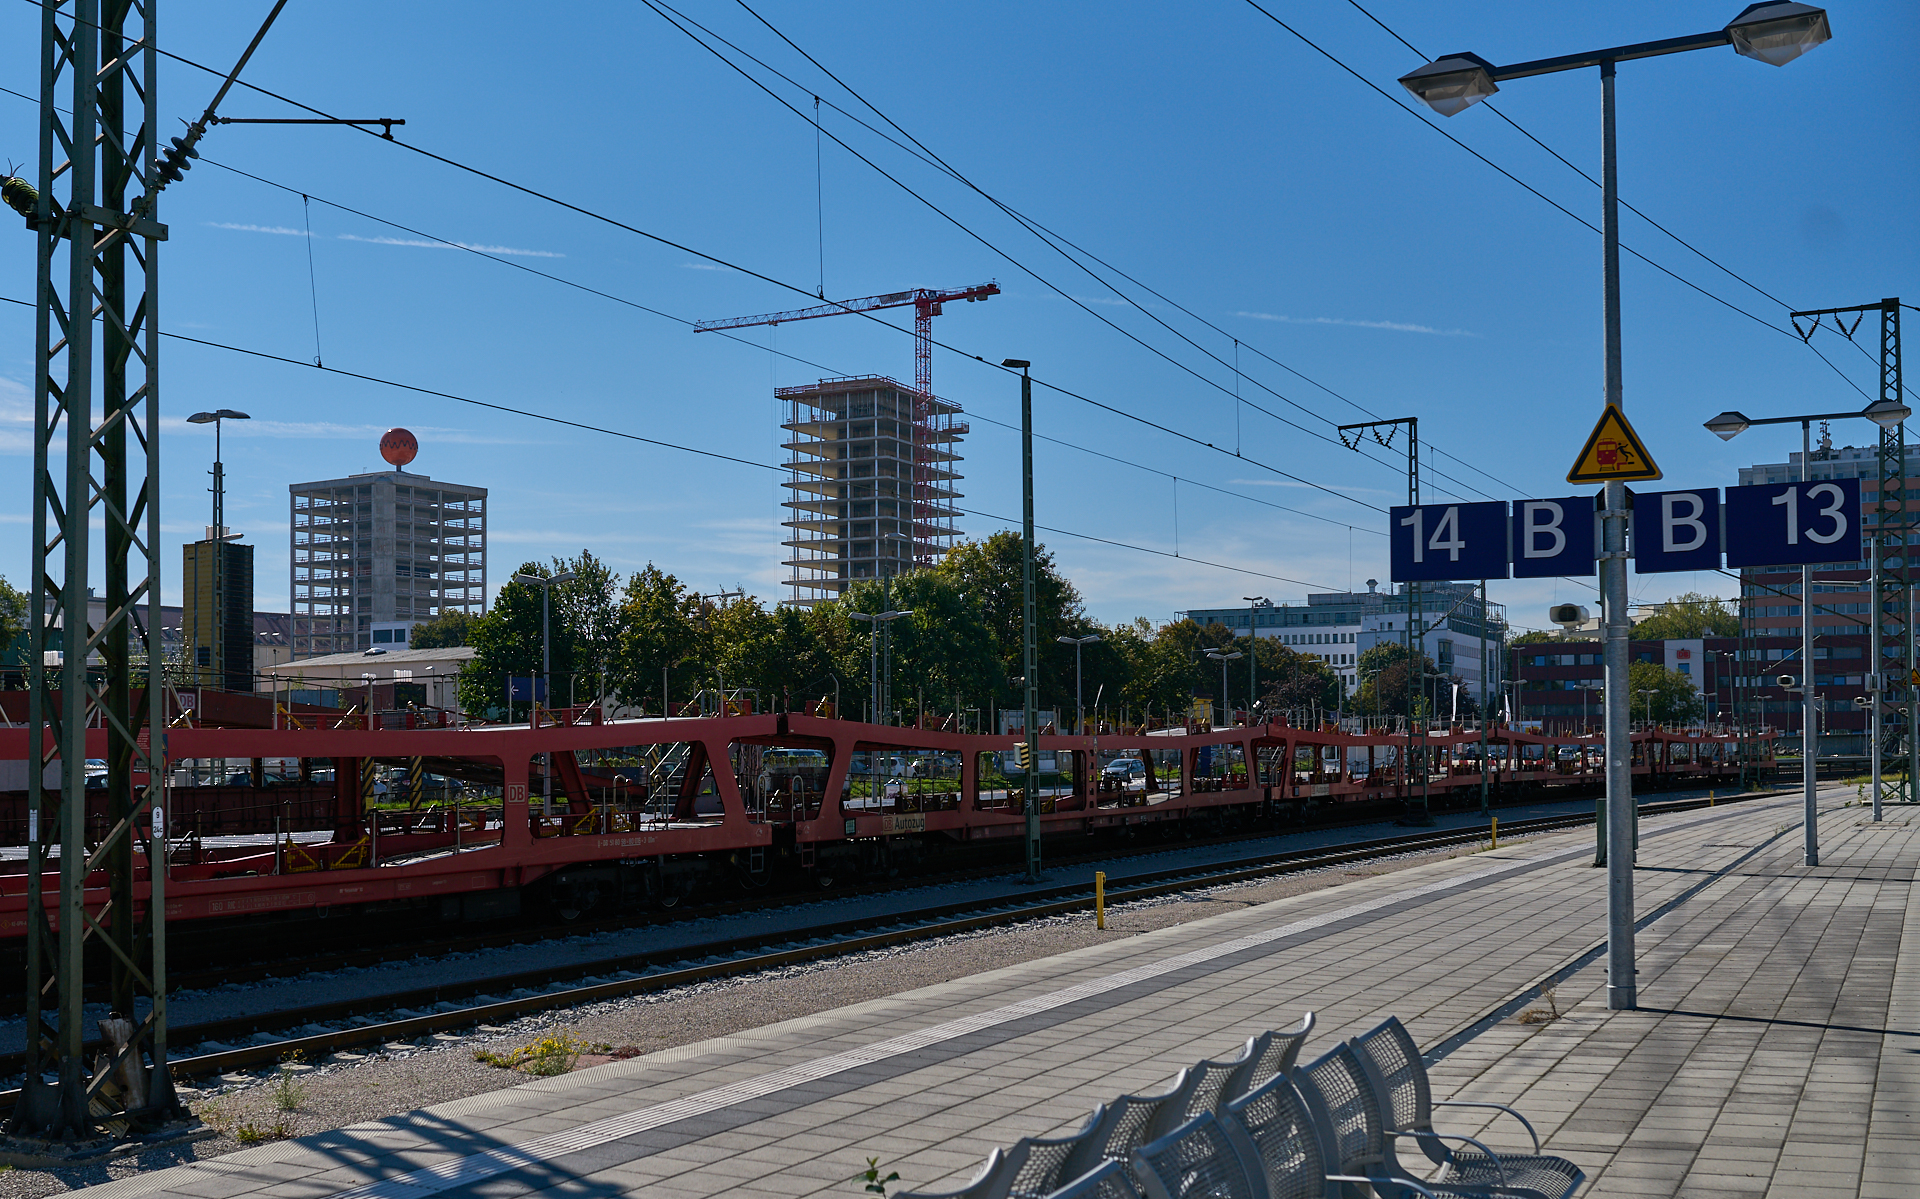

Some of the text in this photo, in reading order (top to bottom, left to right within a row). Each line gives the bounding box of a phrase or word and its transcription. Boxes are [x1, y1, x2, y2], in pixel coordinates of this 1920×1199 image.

[1771, 483, 1848, 545] 13
[1523, 501, 1567, 559] B
[1661, 493, 1708, 553] B
[1400, 506, 1466, 563] 14
[179, 695, 194, 707] DB
[509, 786, 524, 801] DB
[155, 811, 160, 819] 9
[894, 817, 925, 831] Autozug
[212, 902, 223, 911] 160
